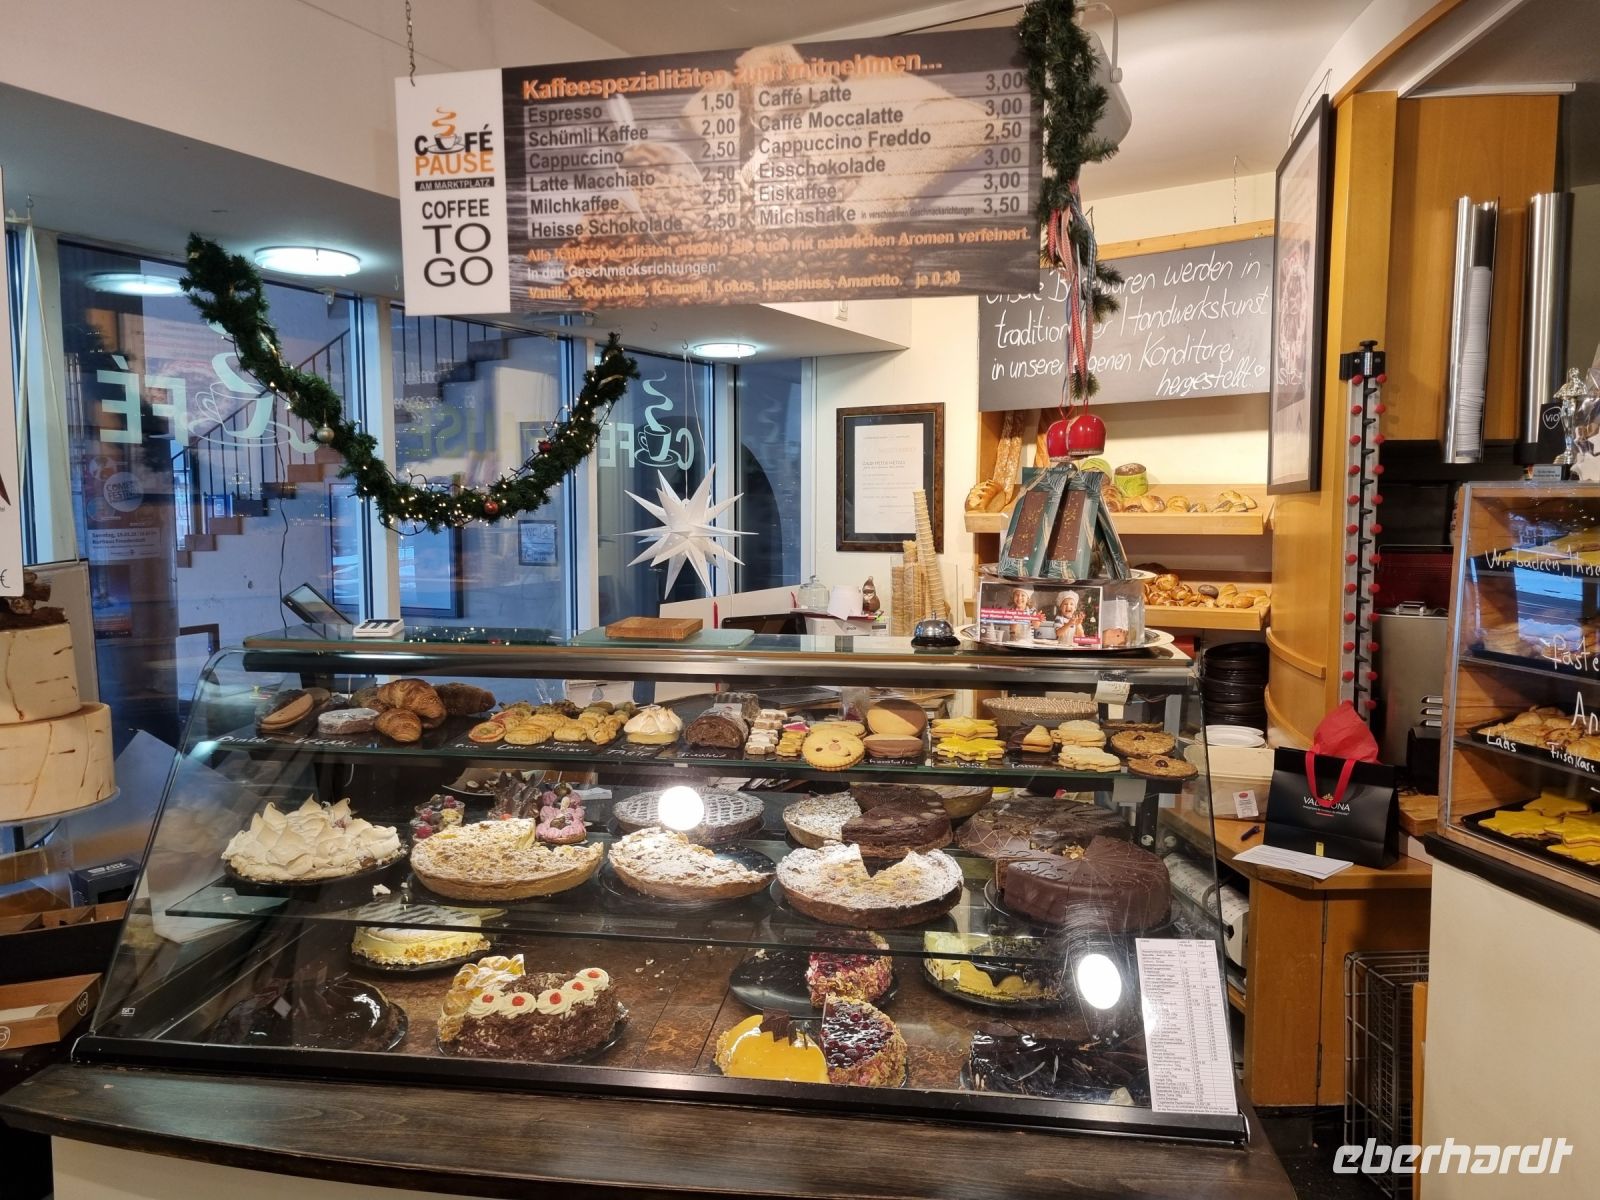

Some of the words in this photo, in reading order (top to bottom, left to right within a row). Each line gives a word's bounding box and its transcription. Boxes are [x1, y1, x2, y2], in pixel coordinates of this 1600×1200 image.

[523, 68, 728, 99] Kaffeespezialitäten
[733, 65, 782, 86] zum
[787, 53, 942, 79] mitnehmen...
[759, 89, 802, 107] Caffé
[808, 87, 852, 104] Latte
[985, 72, 1023, 94] 3,00
[528, 106, 602, 127] Espresso
[701, 93, 734, 112] 1,50
[759, 113, 802, 132] Caffé
[809, 107, 904, 128] Moccalatte
[985, 98, 1022, 119] 3,00
[529, 128, 593, 147] Schümli
[598, 125, 648, 143] Kaffee
[702, 119, 735, 137] 2,00
[759, 134, 862, 157] Cappuccino
[868, 128, 931, 148] Freddo
[984, 121, 1021, 143] 2,50
[415, 150, 494, 176] PAUSE
[529, 149, 624, 172] Cappuccino
[702, 141, 736, 160] 2,50
[759, 156, 886, 178] Eisschokolade
[984, 147, 1021, 168] 3,00
[419, 181, 433, 191] AM
[434, 178, 491, 190] MARKTPLATZ
[530, 176, 568, 192] Latte
[574, 172, 655, 190] Macchiato
[702, 166, 735, 184] 2,50
[759, 183, 837, 201] Eiskaffee
[983, 171, 1020, 193] 3,00
[422, 199, 490, 220] COFFEE
[531, 195, 619, 214] Milchkaffee
[703, 189, 736, 207] 2,50
[760, 206, 856, 226] Milchshake
[983, 196, 1020, 217] 3,50
[422, 223, 491, 254] TO
[532, 222, 583, 238] Heisse
[589, 216, 683, 235] Schokolade
[703, 213, 736, 232] 2,50
[555, 243, 672, 261] Kaffeespezialitäten
[792, 236, 813, 250] mit
[817, 232, 895, 250] natürlichen
[898, 230, 955, 247] Aromen
[958, 226, 1031, 245] verfeinert.
[424, 256, 493, 287] GO
[1164, 250, 1233, 286] werden
[1241, 252, 1260, 279] in
[528, 285, 571, 300] Vanille,
[575, 281, 649, 298] Schokolade,
[714, 277, 759, 294] Kokos,
[763, 275, 834, 291] Haselnuss,
[915, 272, 928, 289] je
[931, 270, 961, 287] 0,30
[1120, 285, 1269, 337] Handwerkskunst
[991, 358, 1004, 381] in
[1010, 357, 1064, 380] unserer
[1139, 328, 1234, 371] Konditorei
[1485, 548, 1511, 569] Wir
